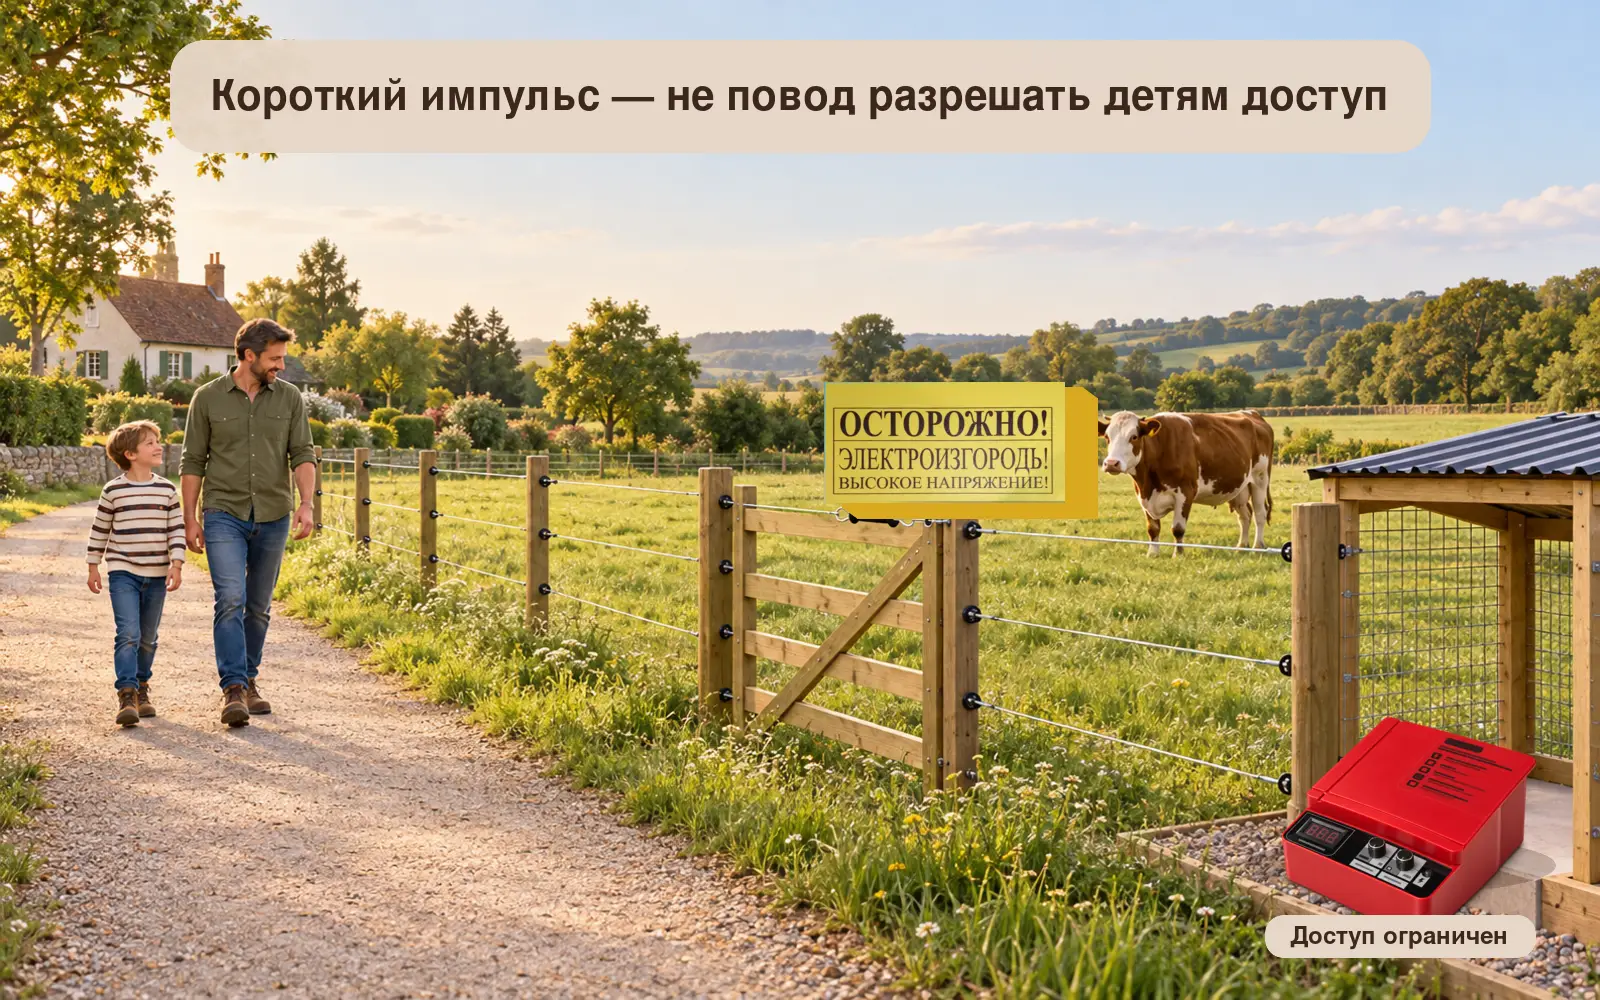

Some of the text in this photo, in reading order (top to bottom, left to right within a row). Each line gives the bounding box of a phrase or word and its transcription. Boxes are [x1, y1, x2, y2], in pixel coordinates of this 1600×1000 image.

[839, 409, 1048, 438] ОСТОРОЖНО!
[838, 447, 1048, 475] ЭЛЕКТРОИЗГОРОДЬ!
[838, 476, 1048, 489] ВЫСОКОЕ НАПРЯЖЕНИЕ!
